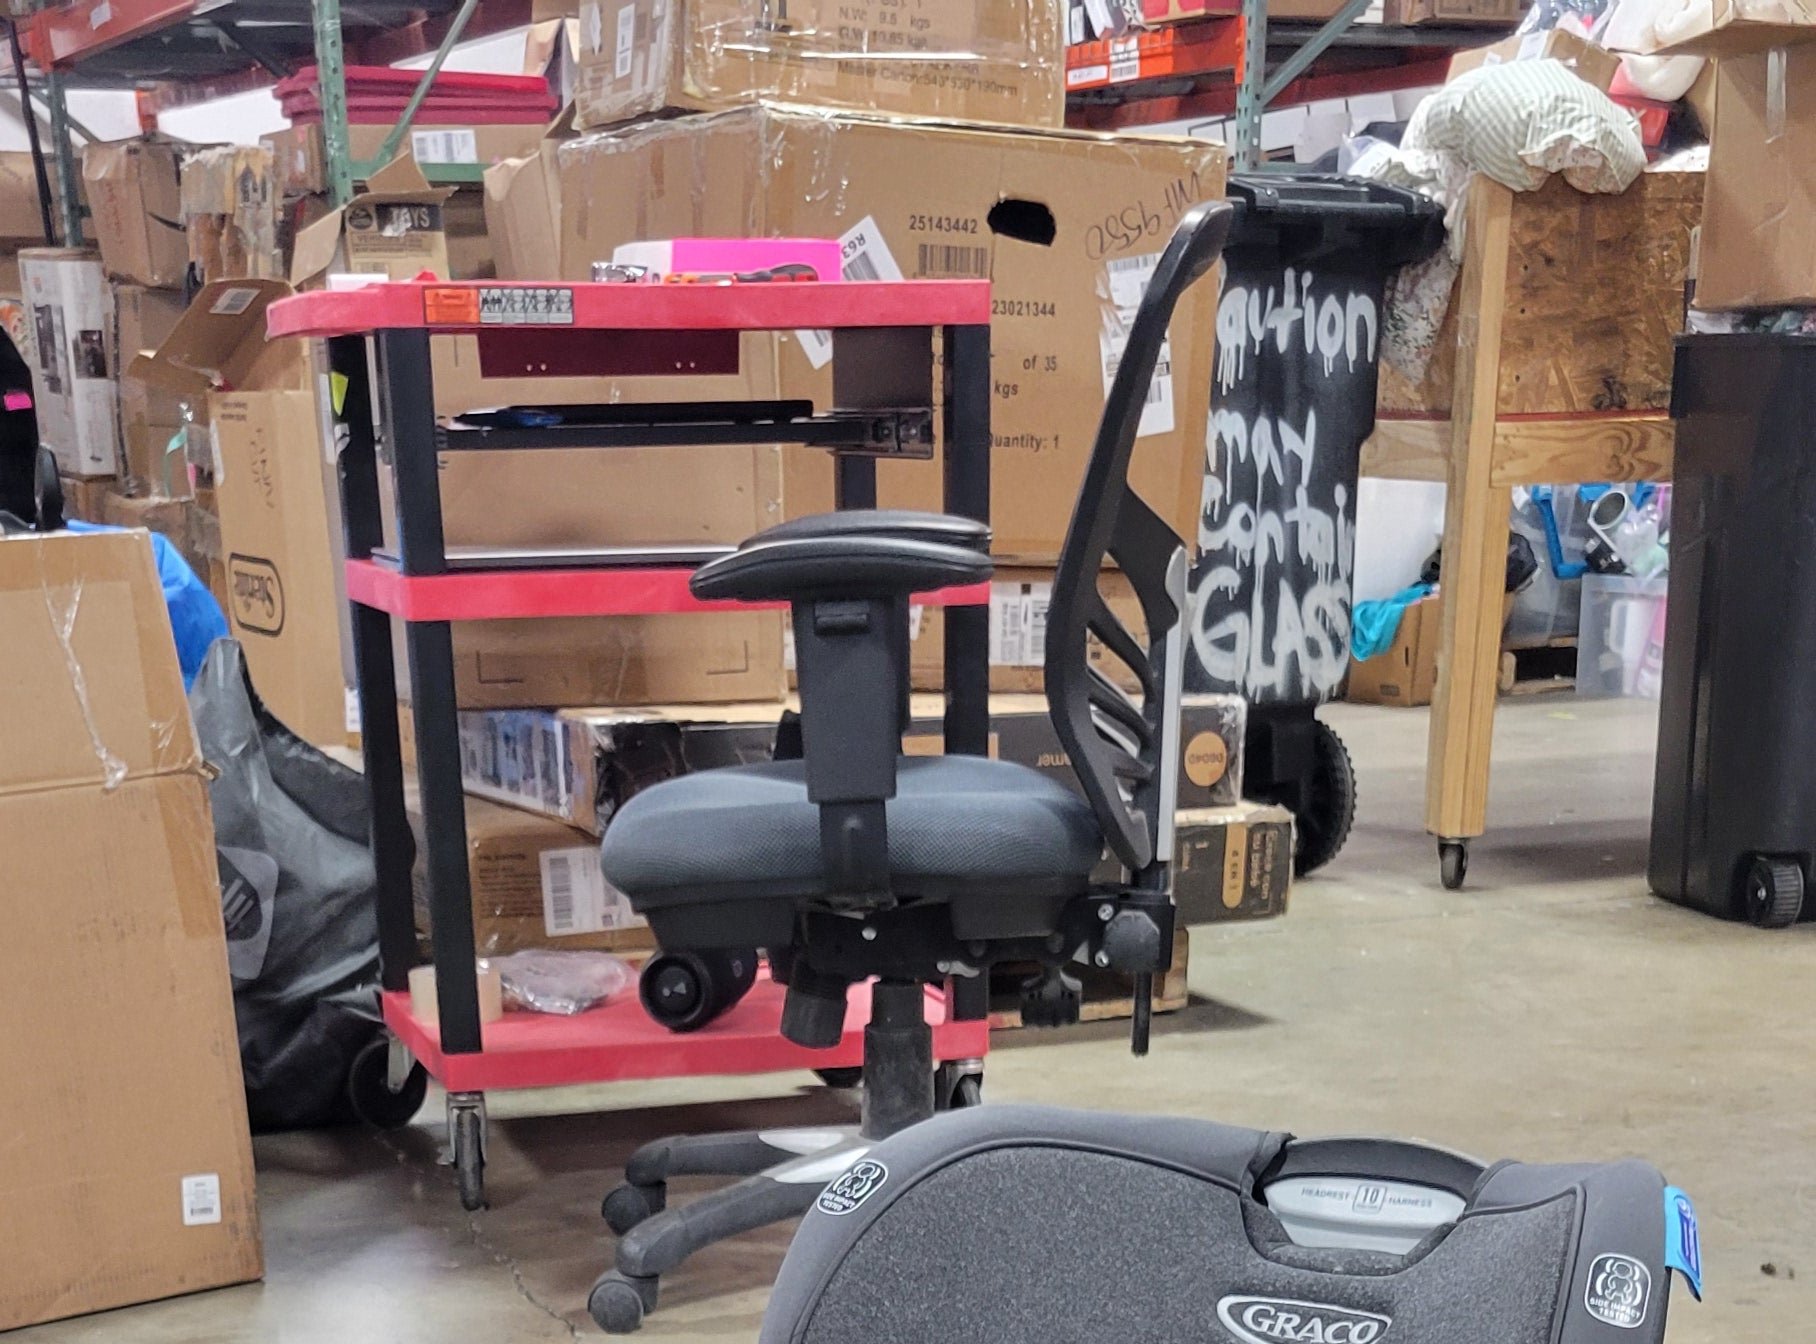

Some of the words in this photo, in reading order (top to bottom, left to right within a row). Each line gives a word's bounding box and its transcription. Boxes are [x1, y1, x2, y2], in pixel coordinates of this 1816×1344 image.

[909, 214, 979, 235] 25143442
[991, 299, 1056, 317] 23021344
[1215, 267, 1377, 375] aution
[1022, 355, 1037, 371] of
[1044, 355, 1058, 372] 35
[993, 380, 1019, 399] kgs
[1052, 435, 1060, 450] 1
[1362, 1187, 1380, 1204] 10
[1242, 1304, 1380, 1344] GRACO
